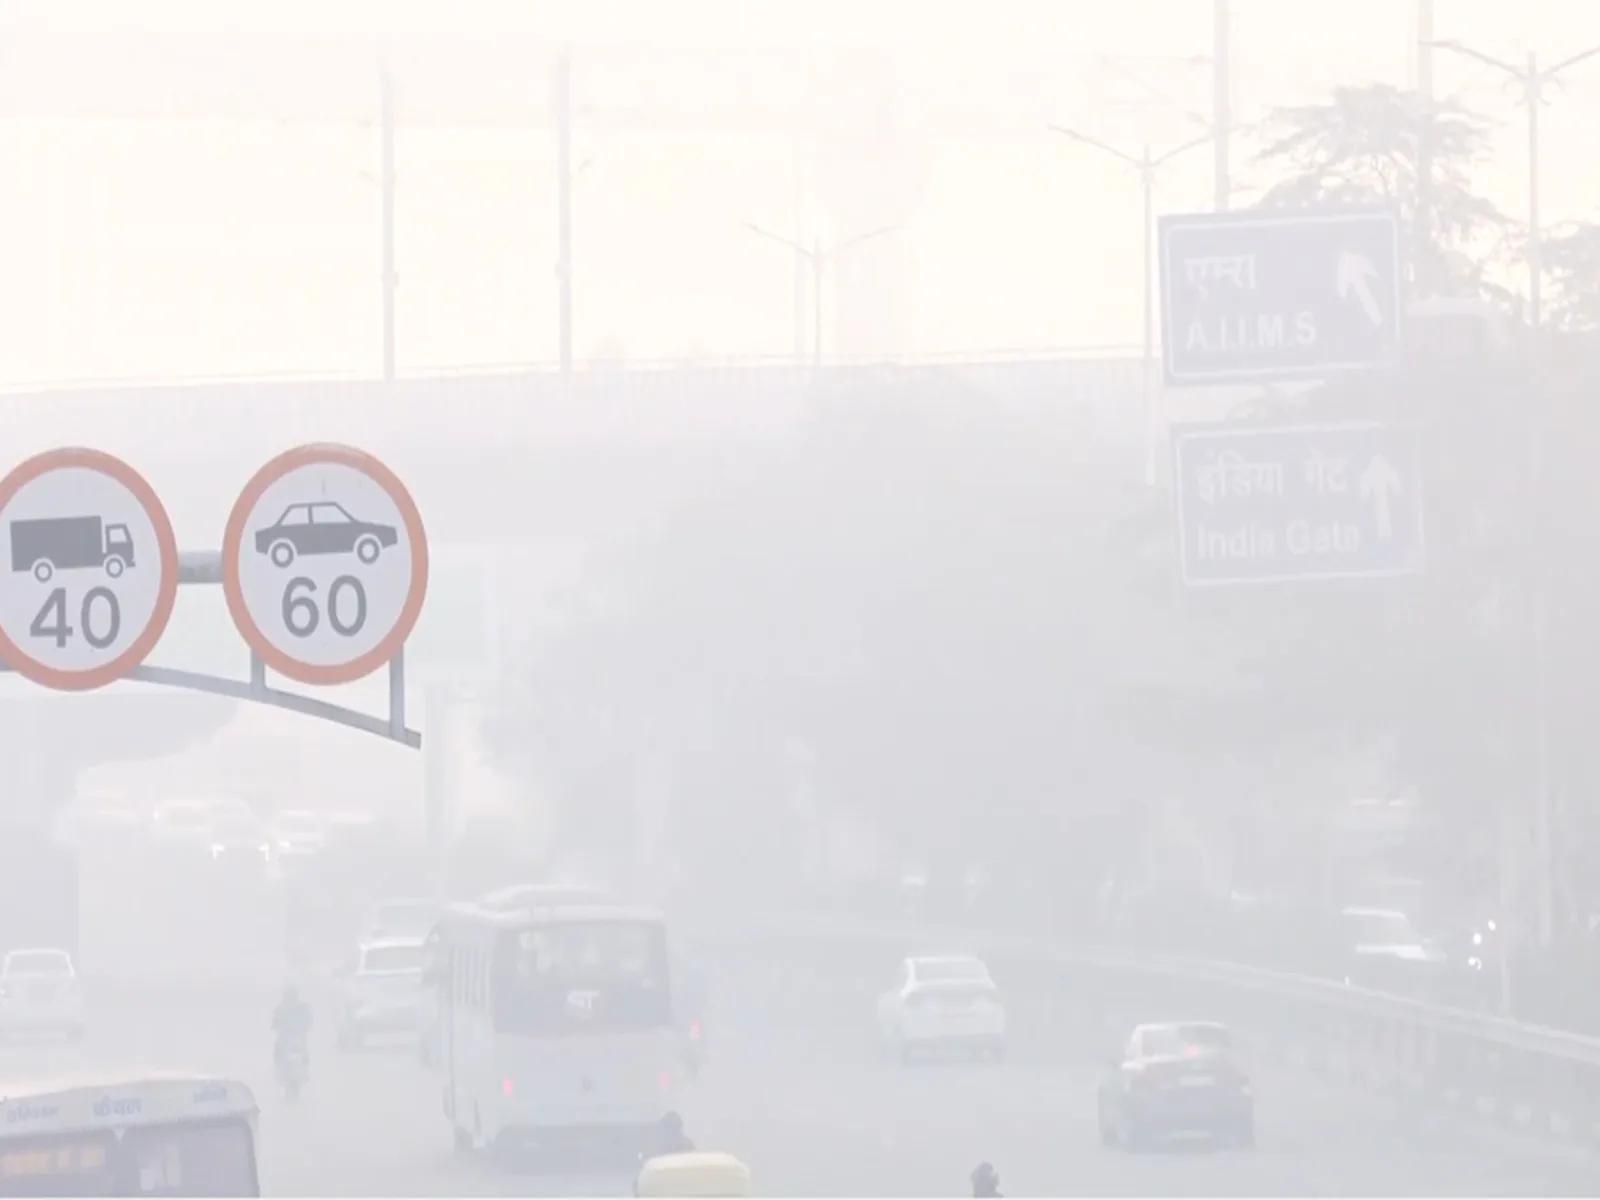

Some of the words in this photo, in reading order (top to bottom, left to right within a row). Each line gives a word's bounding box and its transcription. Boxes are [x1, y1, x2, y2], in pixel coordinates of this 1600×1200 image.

[1194, 448, 1284, 505] इंडिया
[1304, 446, 1350, 495] गेट
[1196, 519, 1276, 560] India
[29, 585, 121, 649] 40
[280, 574, 368, 638] 60
